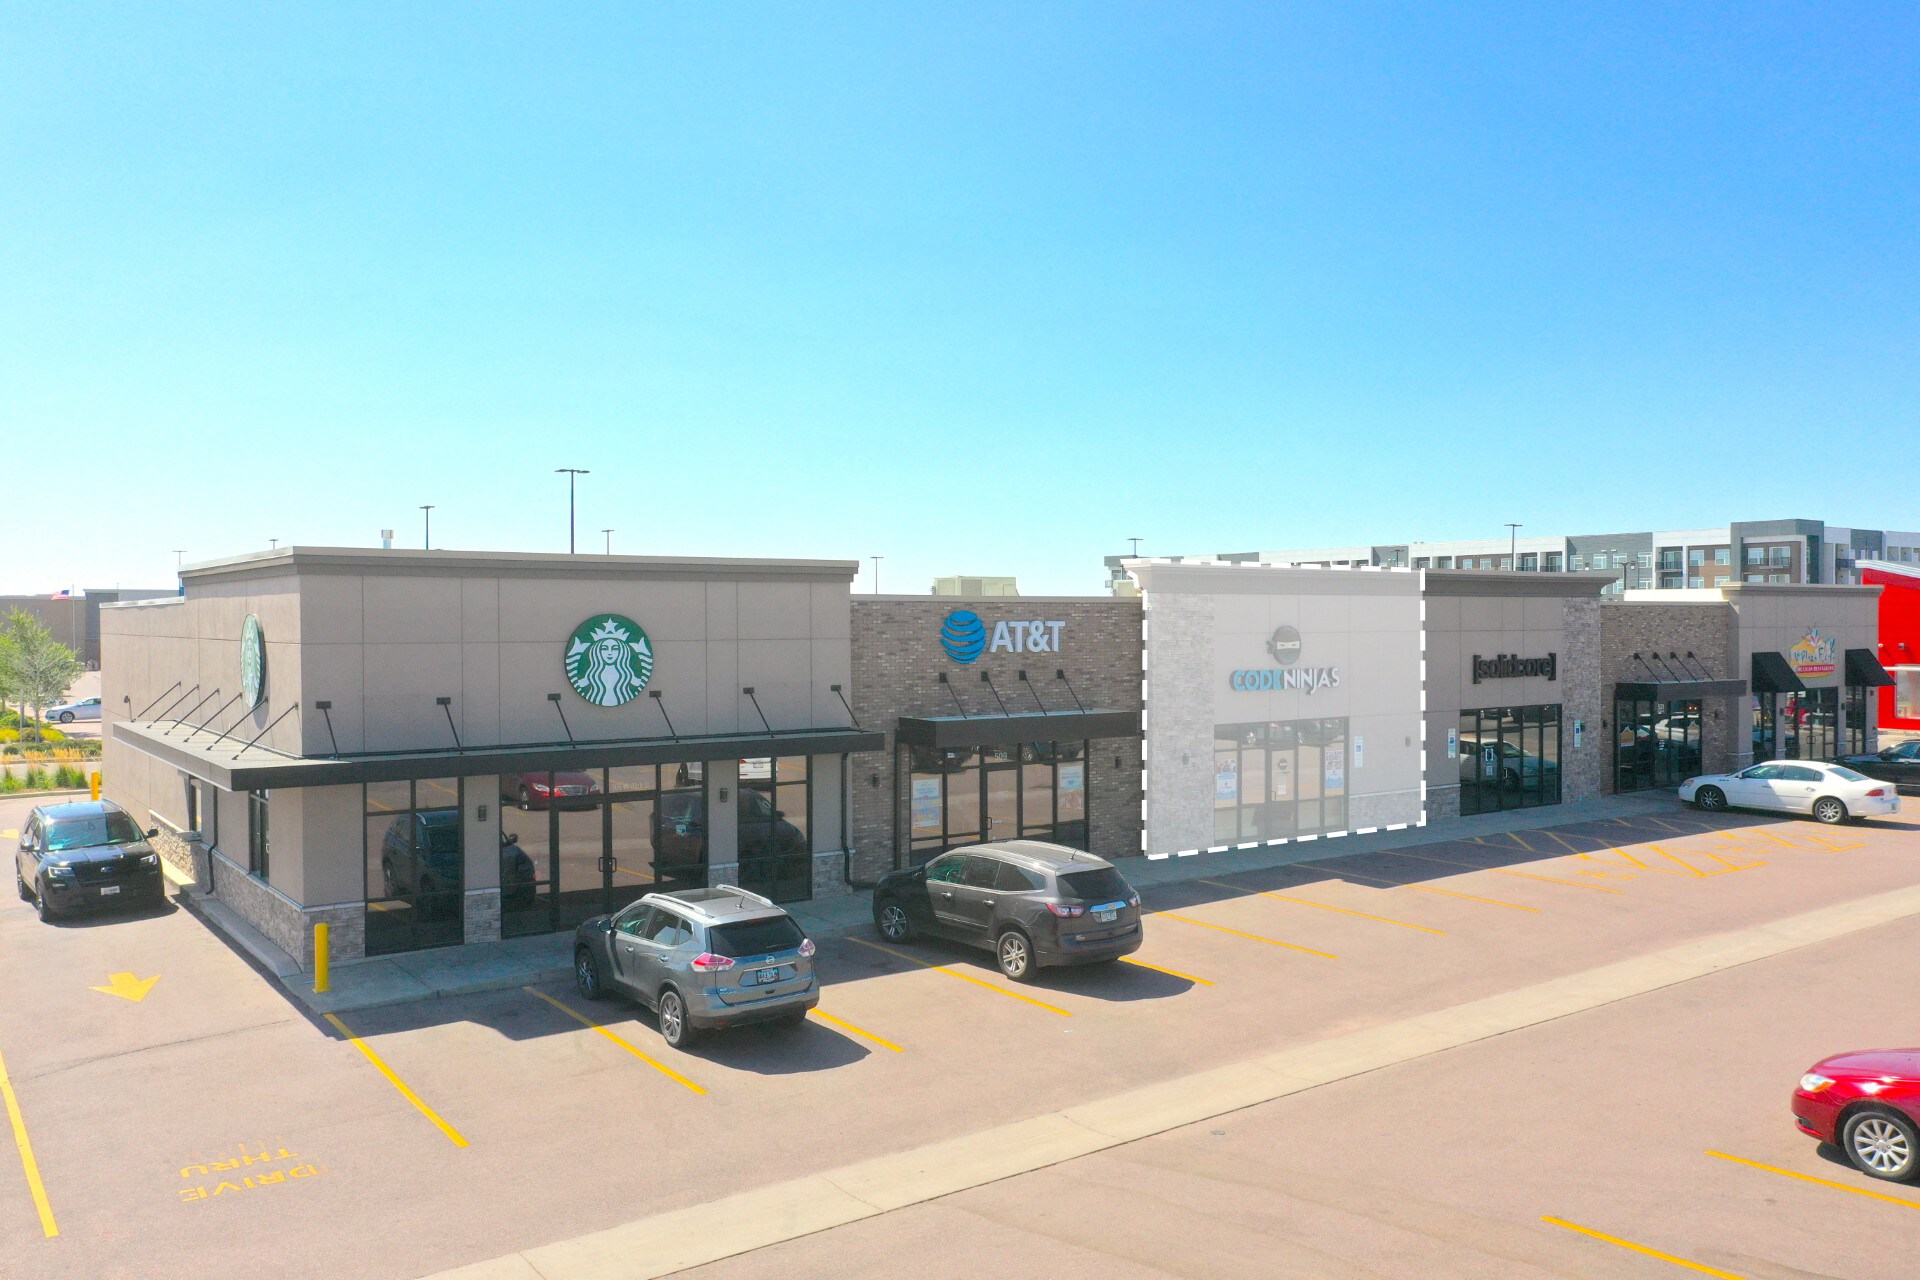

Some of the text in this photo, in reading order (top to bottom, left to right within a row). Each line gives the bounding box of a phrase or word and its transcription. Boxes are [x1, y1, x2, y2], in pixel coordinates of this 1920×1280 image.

[989, 620, 1066, 653] AT&T
[994, 752, 1008, 761] 509
[179, 1148, 299, 1178] THRU
[178, 1164, 319, 1202] DRIVE
